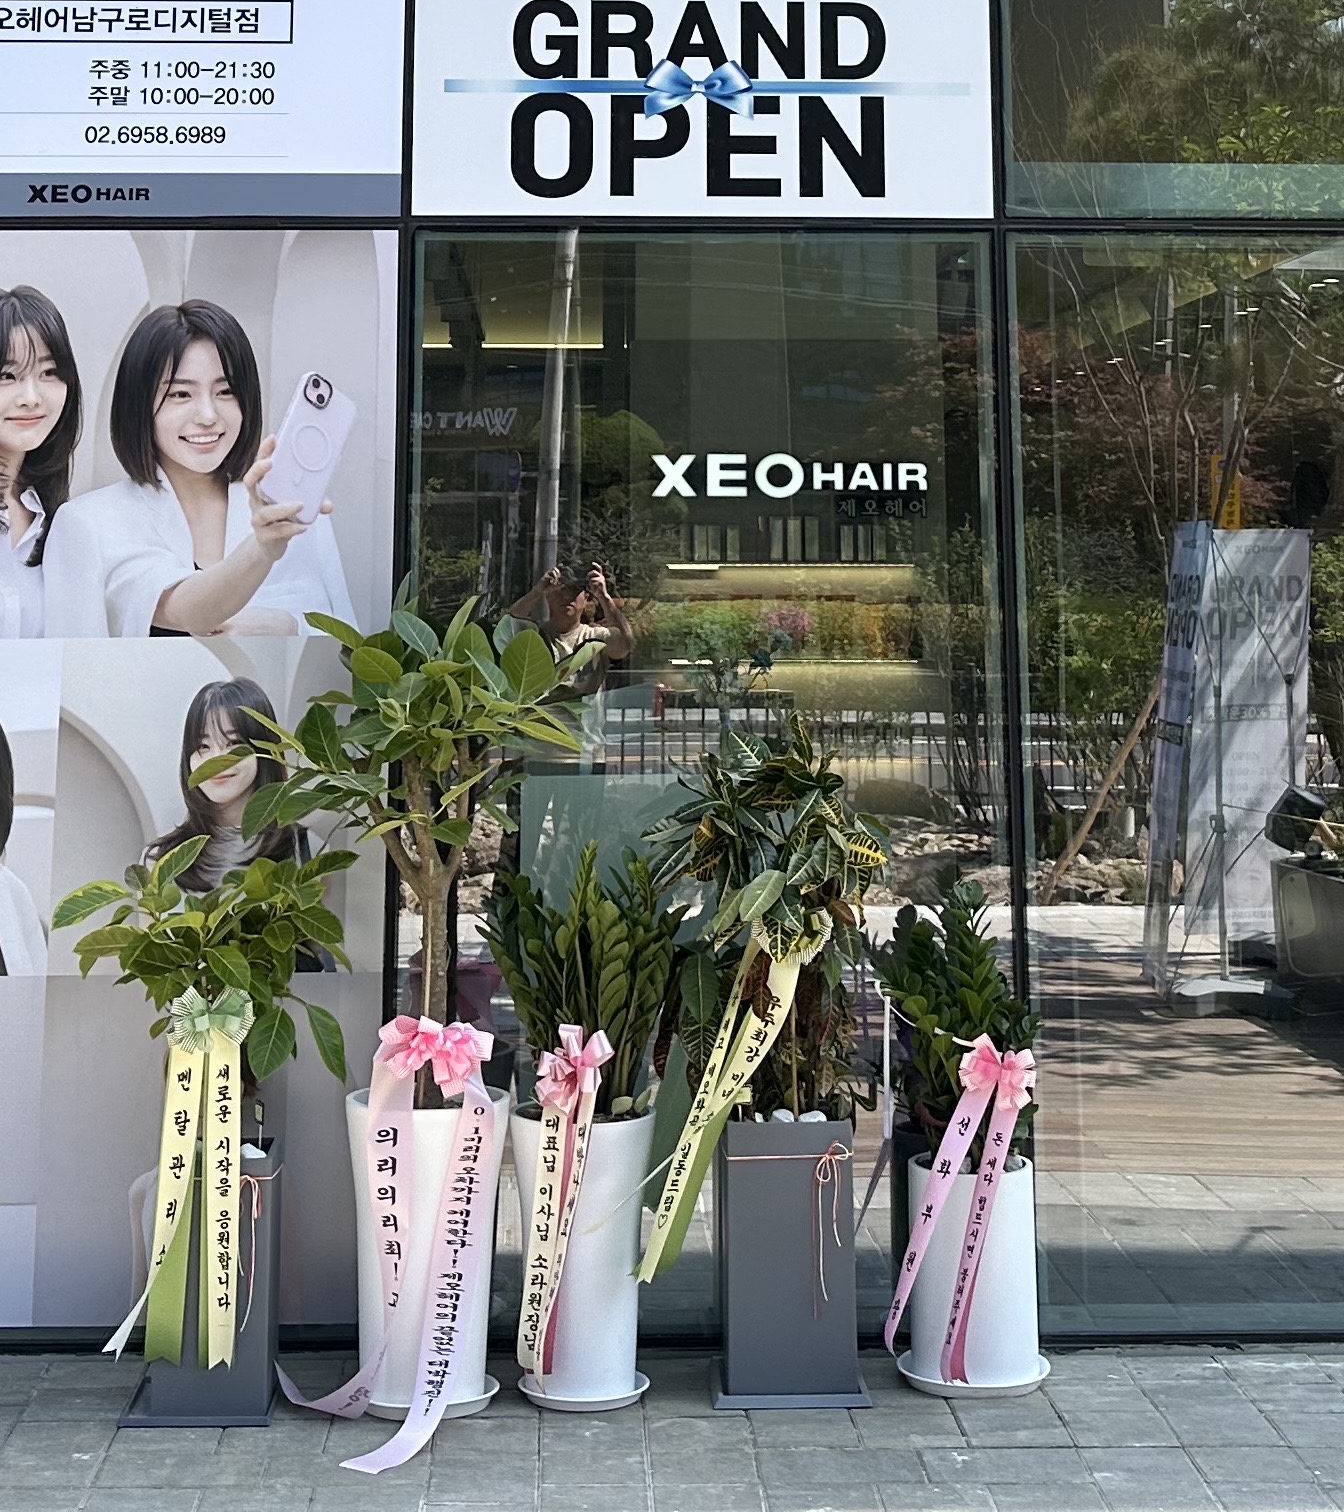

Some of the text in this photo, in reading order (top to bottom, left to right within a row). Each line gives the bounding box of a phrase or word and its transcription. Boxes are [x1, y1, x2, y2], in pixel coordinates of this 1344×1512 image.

[88, 59, 131, 81] 주중
[87, 85, 131, 107] 주말
[84, 125, 227, 146] 02.6958.6989
[510, 92, 886, 199] OPEN
[837, 498, 928, 518] 제오헤어
[542, 1114, 560, 1173] 대표님
[991, 1131, 1004, 1147] 돈
[215, 1063, 233, 1313] 새로운 시작을 응원합니다
[535, 1183, 555, 1242] 이사님
[523, 1253, 549, 1352] 소라원장님
